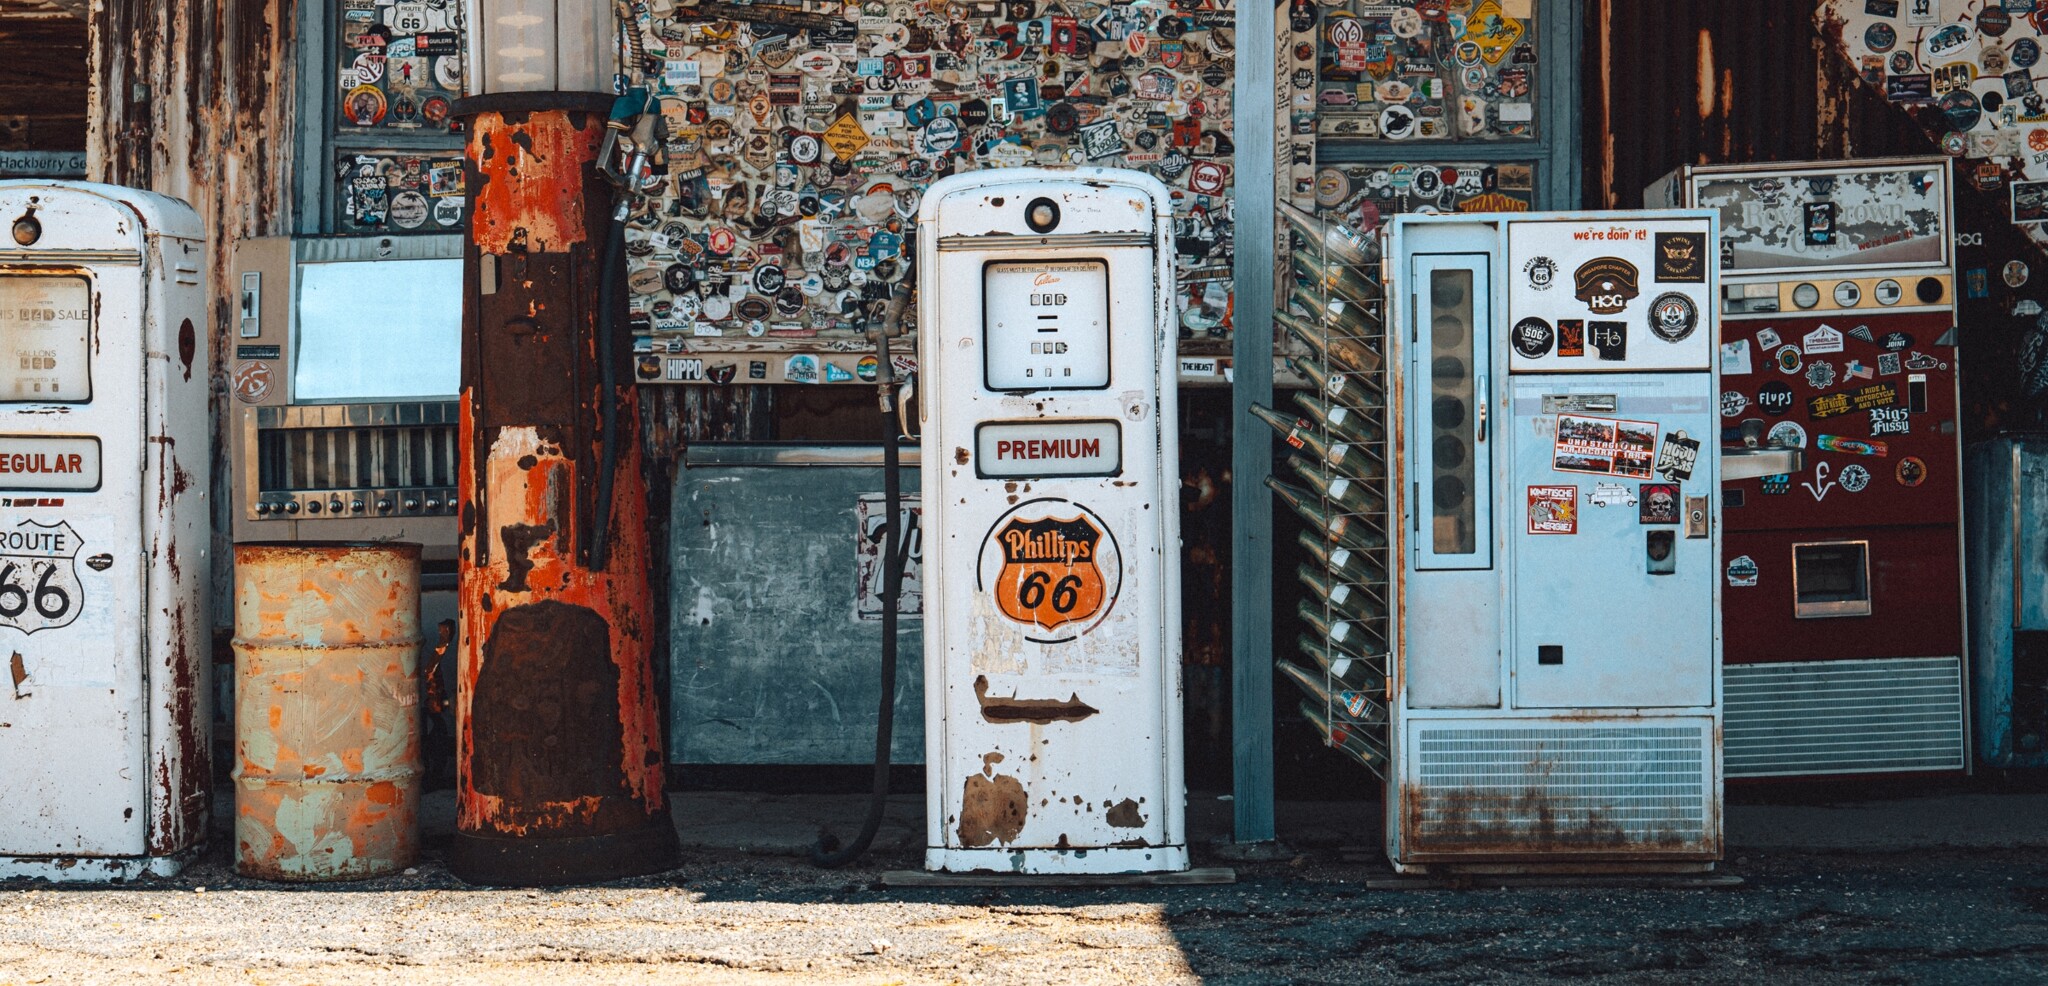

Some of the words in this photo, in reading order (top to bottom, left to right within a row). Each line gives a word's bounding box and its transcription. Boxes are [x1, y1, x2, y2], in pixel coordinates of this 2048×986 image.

[401, 18, 421, 29] 66
[1198, 10, 1236, 26] Techniqu
[669, 49, 681, 58] 66
[1132, 107, 1149, 120] 66
[931, 120, 951, 129] MOIN
[827, 132, 865, 141] MOTORCYCLES
[0, 156, 65, 172] Hackberry
[1574, 229, 1605, 240] we're
[1607, 228, 1632, 240] doin'
[1635, 229, 1647, 240] it!
[1858, 240, 1881, 251] we're
[857, 258, 876, 268] N34
[1663, 262, 1693, 274] UZBEKISTAN
[1580, 264, 1608, 279] SINGAPORE
[1608, 265, 1631, 276] CHAPTER
[1591, 294, 1623, 308] HOG
[58, 309, 89, 321] SALE
[1886, 340, 1906, 348] JOINT
[16, 349, 57, 357] GALLONS
[667, 359, 702, 380] HIPPO
[1854, 389, 1896, 403] MOTORCYCLE
[1864, 386, 1880, 394] RIDE
[1877, 397, 1894, 406] VOTE
[1869, 420, 1910, 437] Fussy
[997, 438, 1100, 460] PREMIUM
[1662, 440, 1697, 463] HOOD
[1831, 439, 1855, 448] PEOPLE
[1870, 444, 1887, 452] COOL
[1529, 487, 1573, 498] KINETISCHE
[1533, 521, 1573, 532] ENERGIE!
[1004, 529, 1091, 568] Phillips
[0, 562, 70, 620] 66
[1019, 570, 1083, 614] 66
